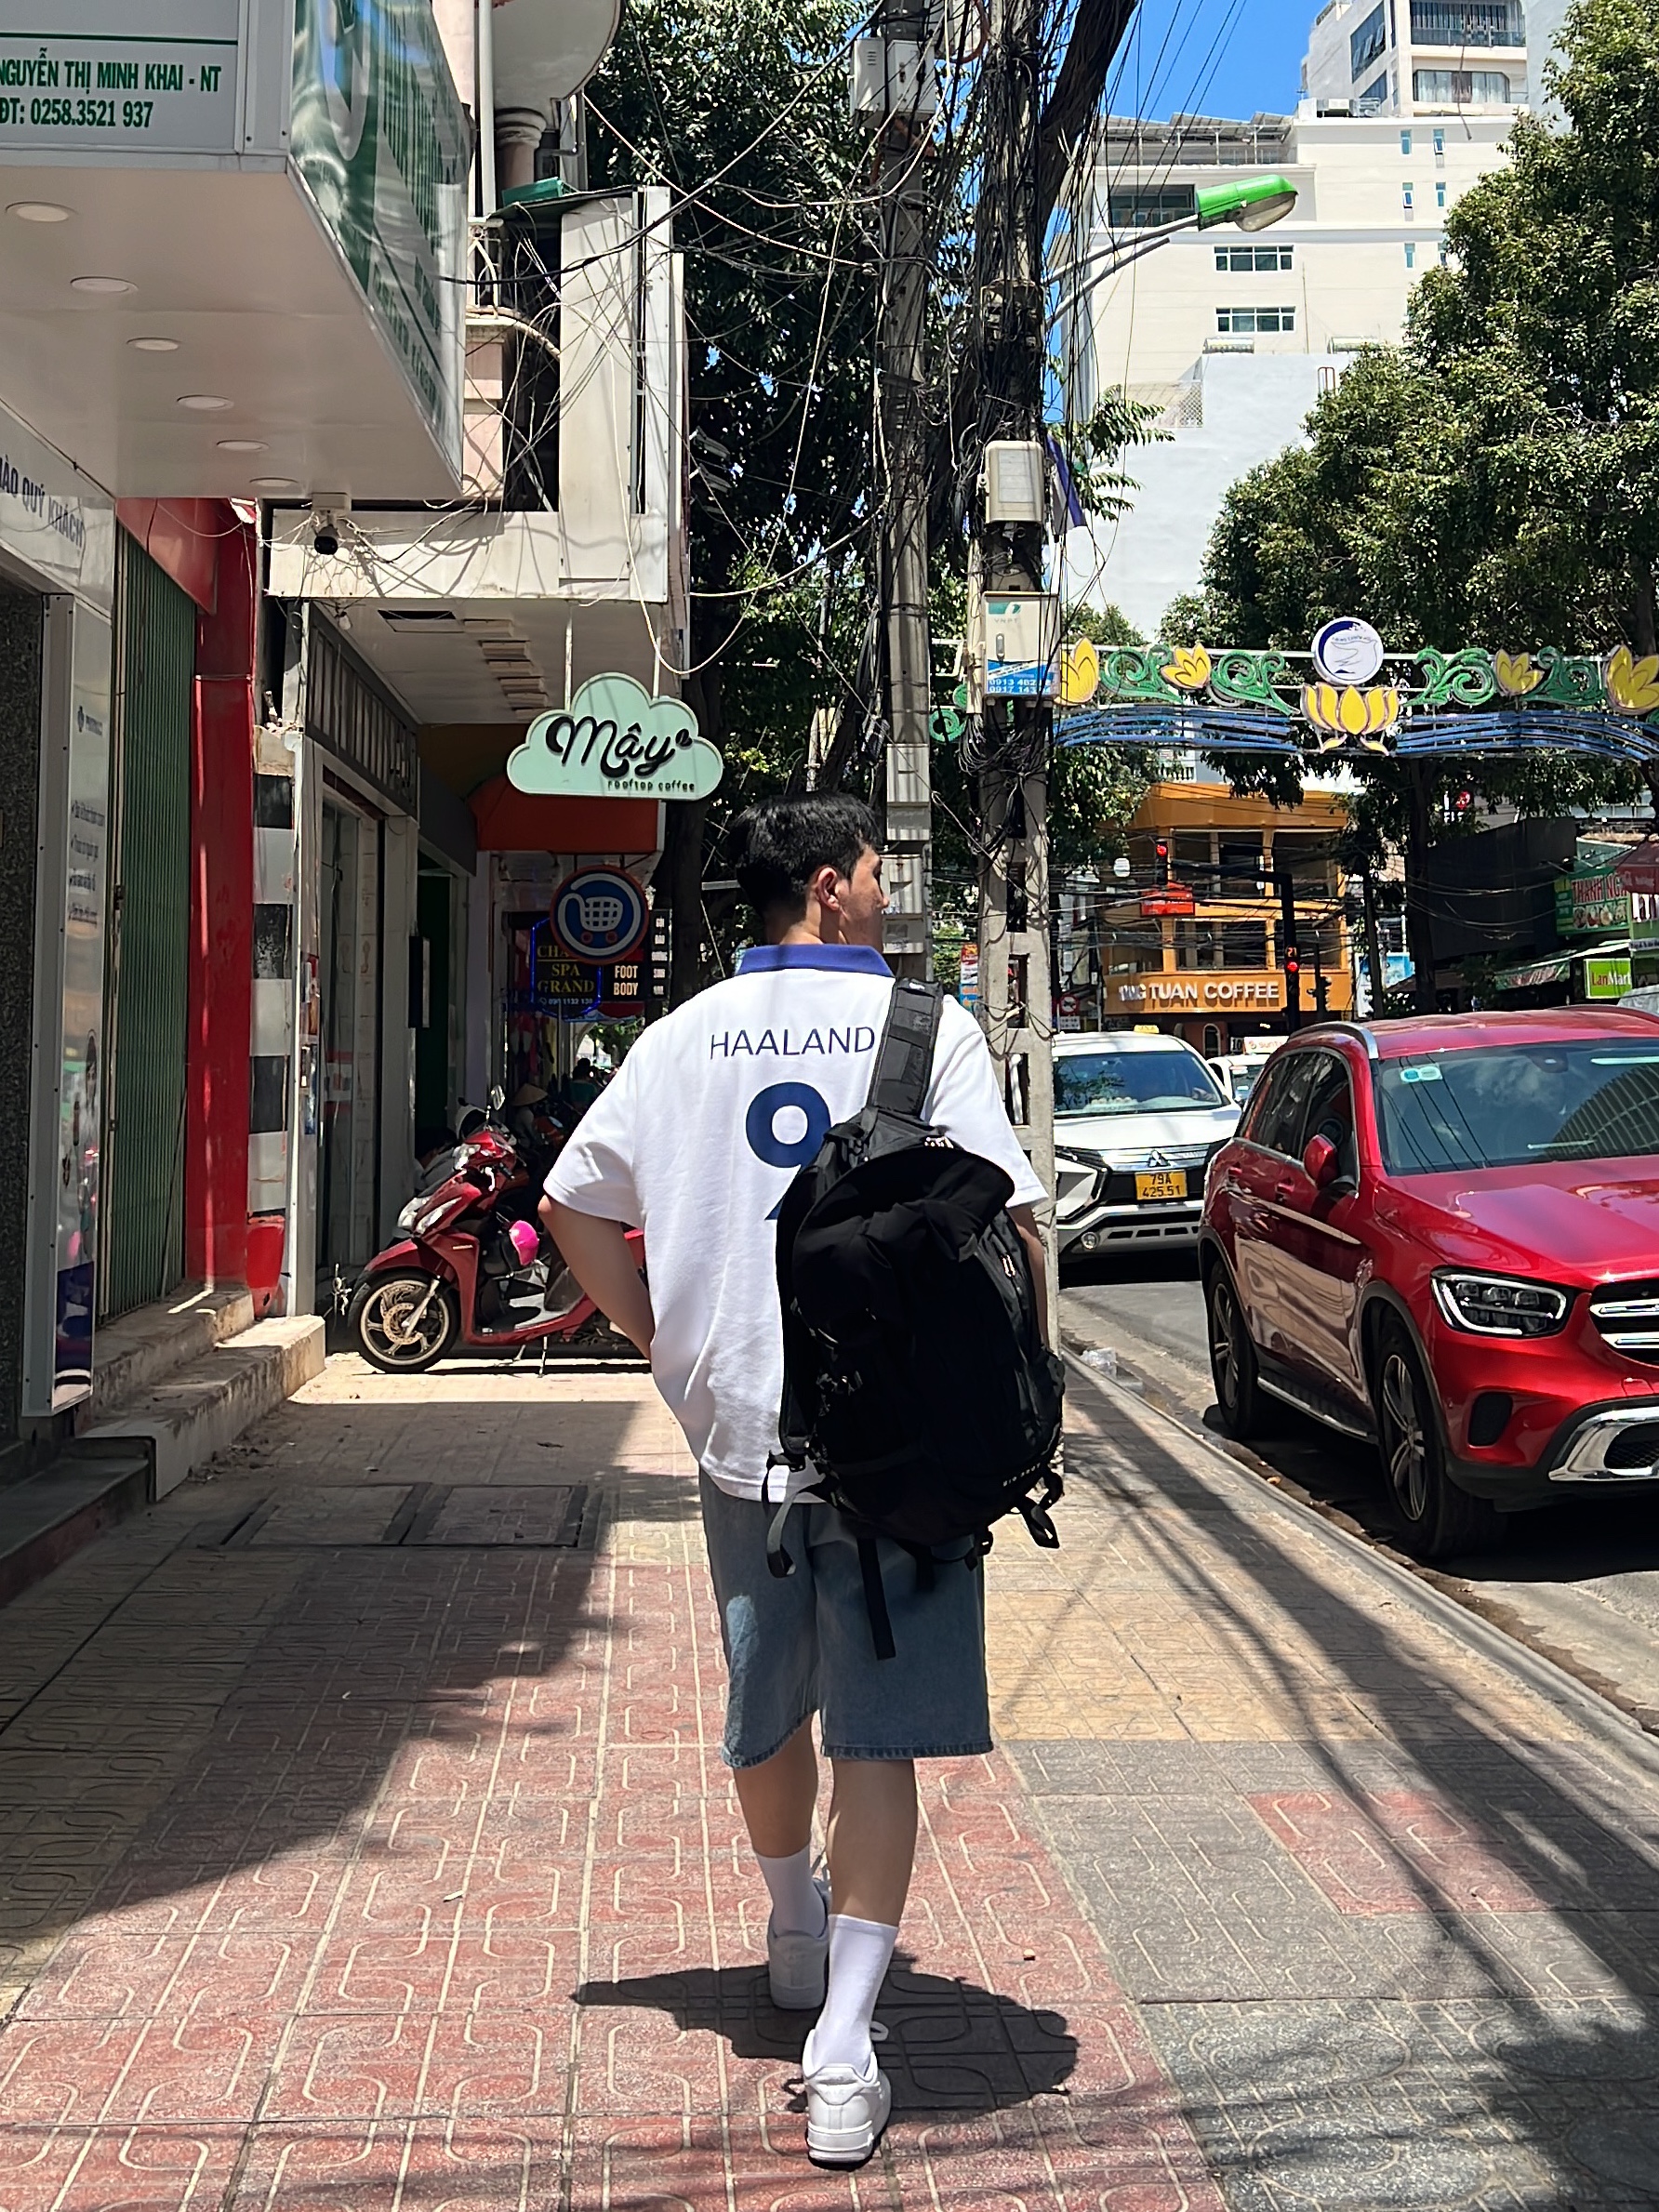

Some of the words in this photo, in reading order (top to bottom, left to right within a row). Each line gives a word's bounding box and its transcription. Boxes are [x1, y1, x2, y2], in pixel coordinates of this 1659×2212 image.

[64, 60, 92, 94] THỊ
[97, 61, 139, 89] MINH
[145, 63, 183, 91] KHAI
[200, 65, 221, 92] NT
[31, 98, 116, 127] 0258.3521
[123, 100, 153, 128] 937
[22, 476, 46, 518] QUÝ
[545, 716, 676, 778] Mây
[607, 778, 654, 792] rooftop
[658, 780, 695, 792] coffee
[538, 945, 569, 958] CHA
[551, 963, 580, 976] SPA
[614, 965, 639, 979] FOOT
[538, 980, 595, 993] GRAND
[613, 982, 639, 996] BODY
[1203, 981, 1280, 1000] COFFEE
[710, 1026, 875, 1060] HAALAND
[745, 1081, 832, 1220] 9
[1149, 1173, 1172, 1185] 79A
